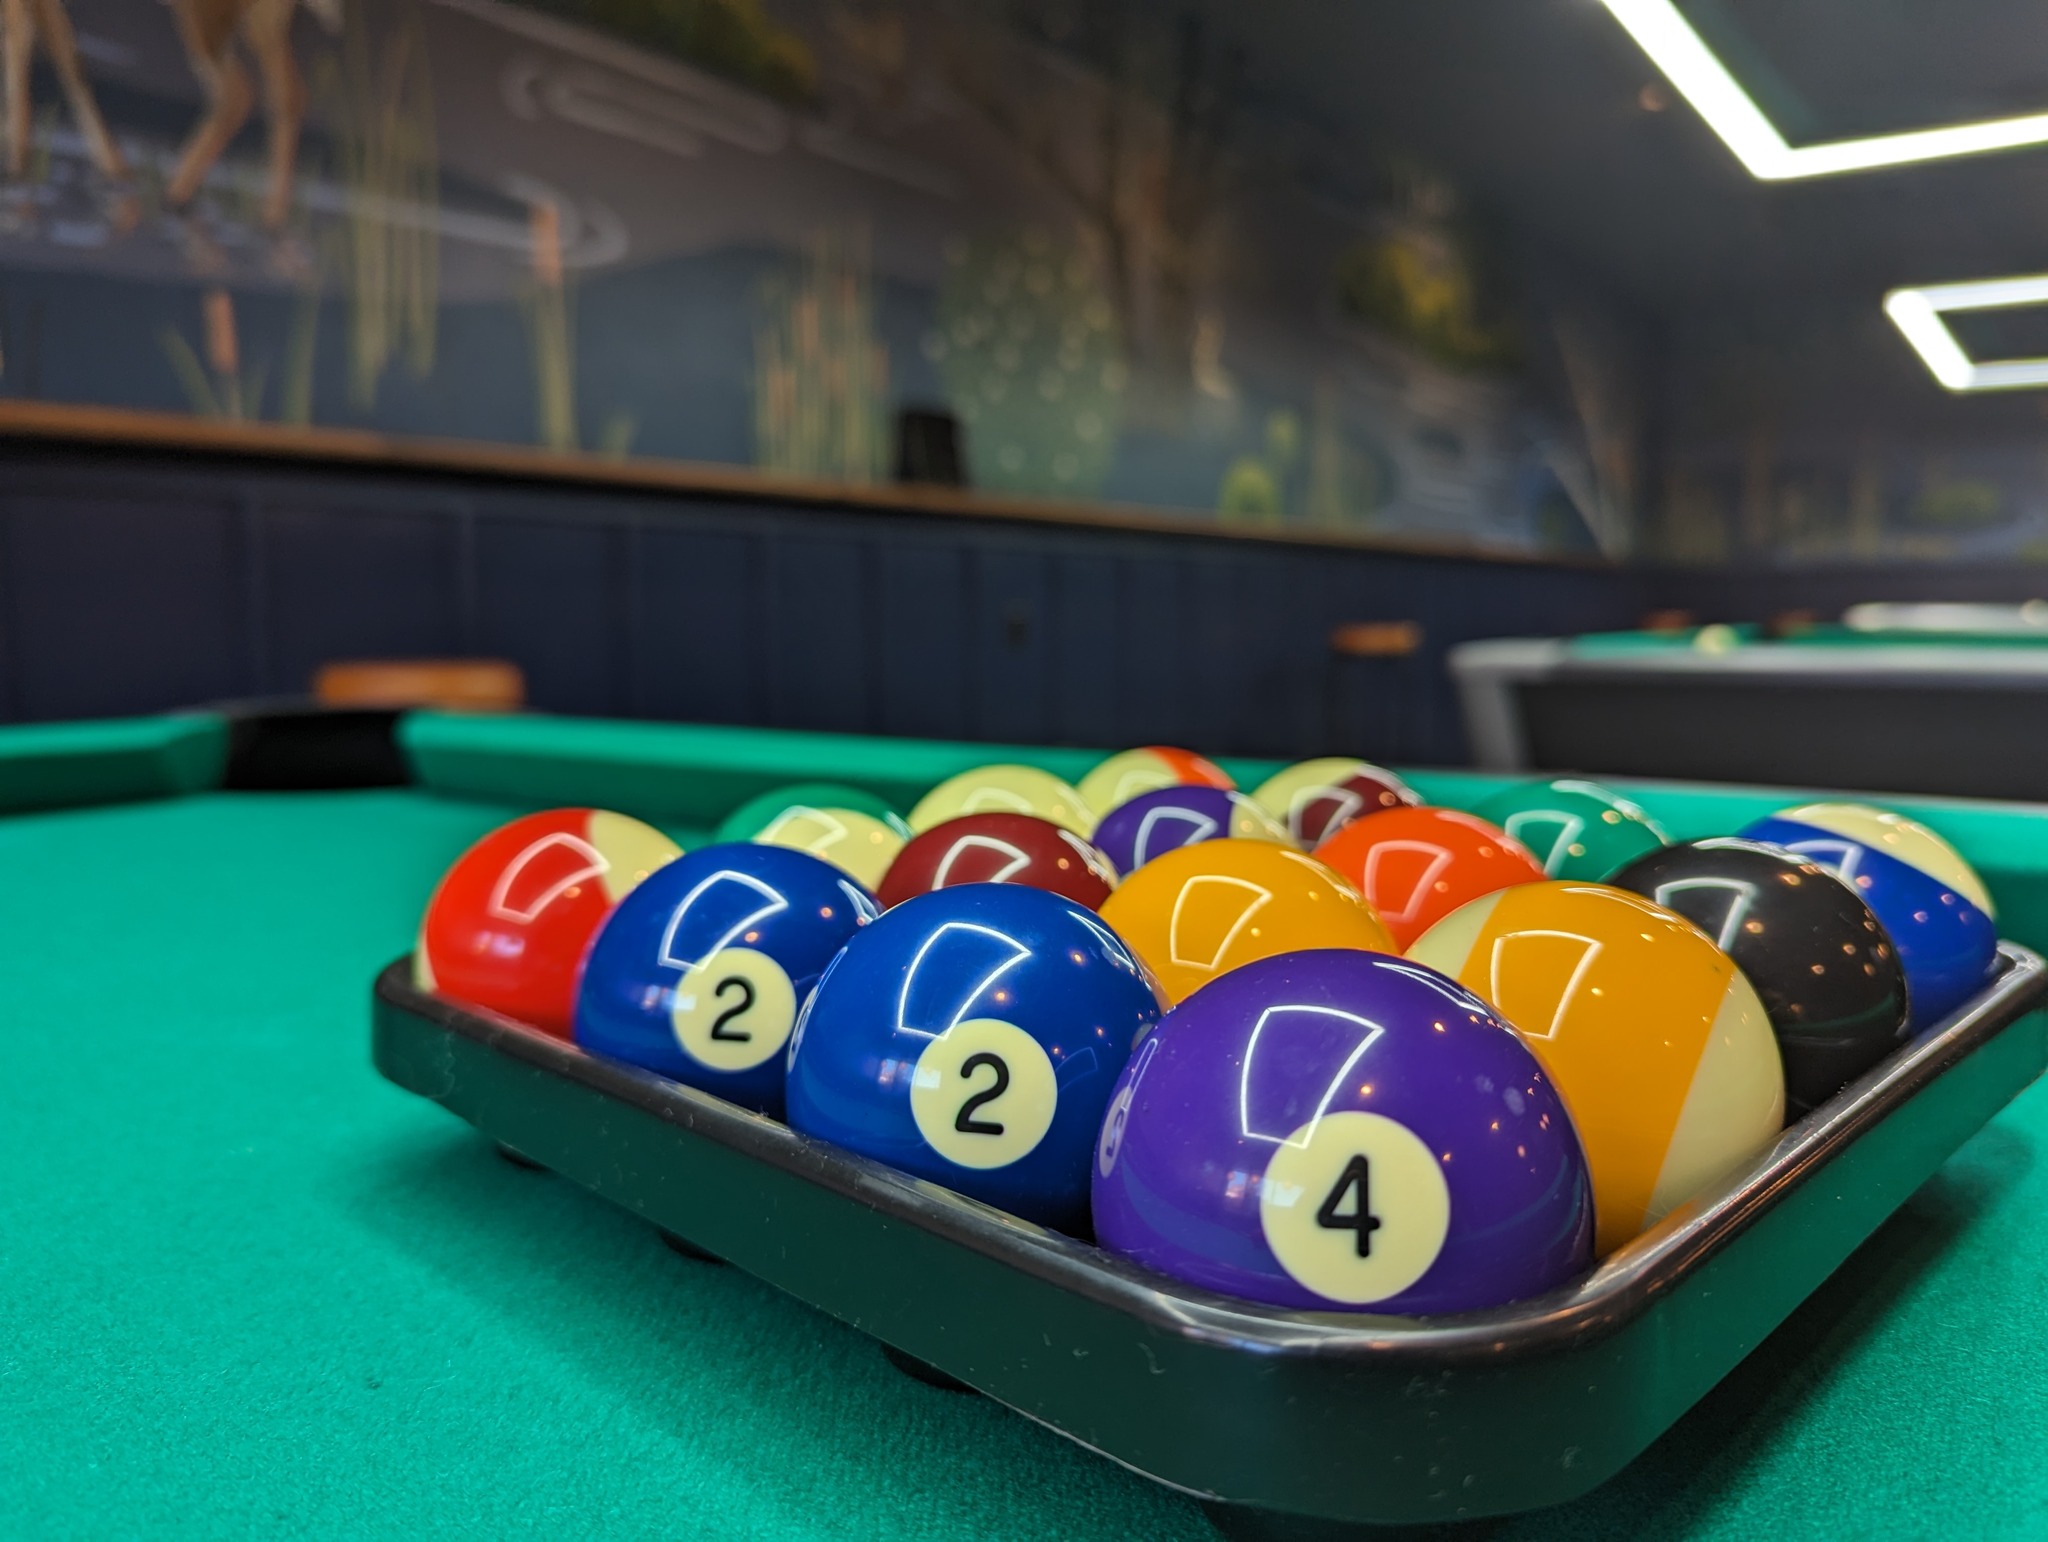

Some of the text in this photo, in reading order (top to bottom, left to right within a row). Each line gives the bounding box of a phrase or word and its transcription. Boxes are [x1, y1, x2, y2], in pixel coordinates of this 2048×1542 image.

[711, 975, 755, 1042] 2
[955, 1052, 1010, 1136] 2
[1316, 1153, 1381, 1258] 4
